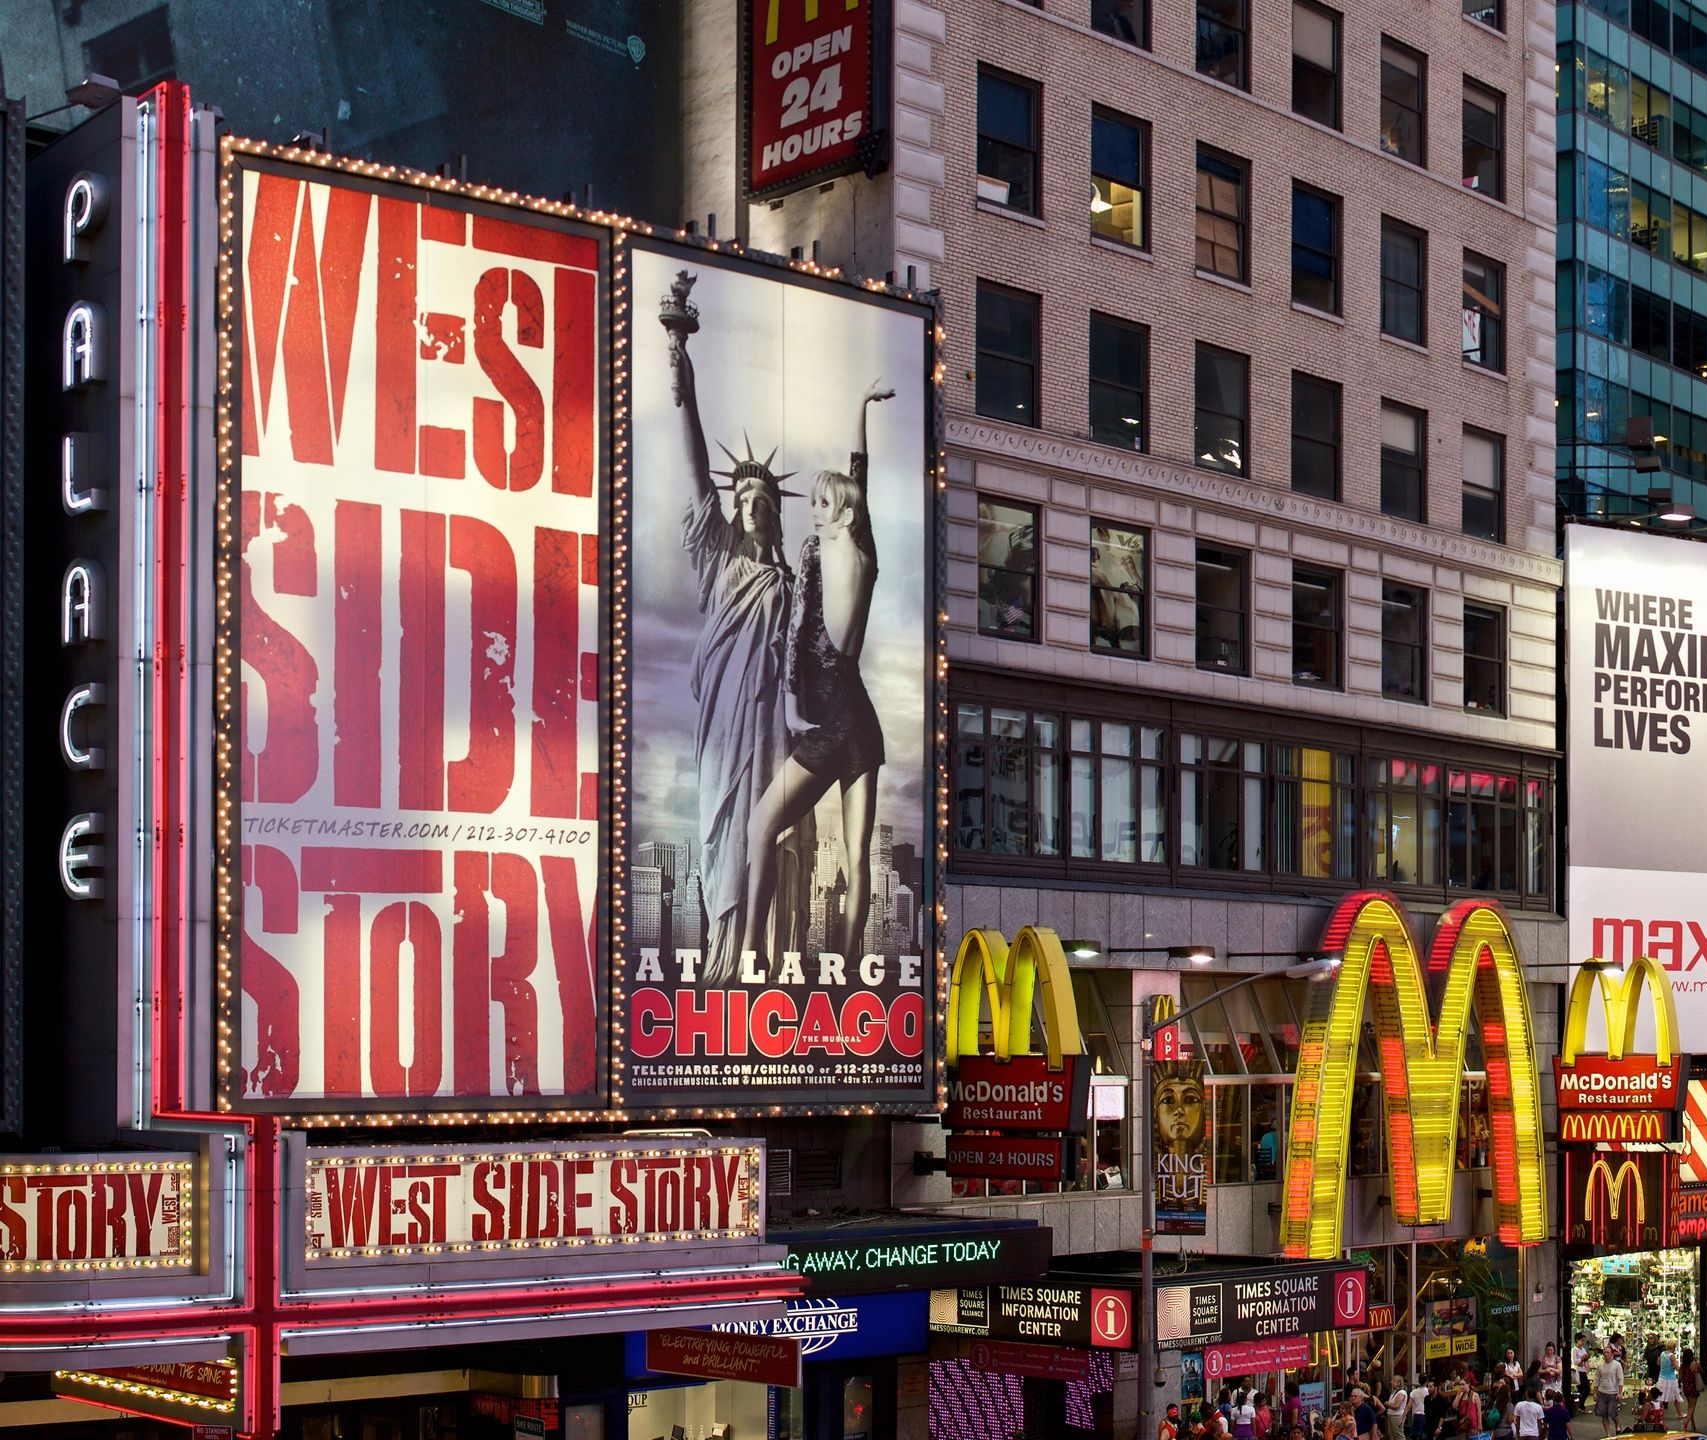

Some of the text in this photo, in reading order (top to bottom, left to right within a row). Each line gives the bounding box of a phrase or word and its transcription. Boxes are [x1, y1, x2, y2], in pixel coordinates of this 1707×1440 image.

[771, 25, 853, 80] OPEN
[780, 63, 843, 129] 24
[761, 110, 863, 172] HOURS
[240, 170, 599, 500] WEST
[58, 174, 107, 903] PALACE
[1594, 587, 1693, 631] WHERE
[240, 489, 599, 822] SIDE
[1593, 706, 1691, 755] LIVES
[466, 823, 592, 846] 212-307-4100
[240, 844, 599, 1101] STORY
[635, 947, 922, 987] AT LARGE
[630, 987, 925, 1058] CHICAGO
[822, 1035, 862, 1043] MUSICAL
[631, 1075, 923, 1087] CHICAGOTHEMUSICAL.COM AMBASSADOR THEATRE BROADWAY
[632, 1063, 923, 1076] TELECHARGE.COM/CHICAGO 212-239-6200
[1559, 1070, 1673, 1090] McDonald's
[949, 1080, 1064, 1103] McDonald's
[1578, 1093, 1653, 1104] Restaurant
[962, 1106, 1043, 1121] Restaurant
[948, 1151, 1055, 1167] OPEN 24 HOURS
[1156, 1153, 1205, 1173] KING
[1157, 1174, 1204, 1199] TUT
[325, 1154, 742, 1249] WEST SIDE STORY
[803, 1239, 1001, 1273] AWAY, CHANGE TODAY
[1000, 1285, 1082, 1306] TIMES SQUARE
[1234, 1276, 1319, 1299] TIMES SQUARE
[1001, 1302, 1080, 1322] INFORMATION
[1236, 1295, 1317, 1319] INFORMATION
[711, 1312, 858, 1336] MONEY EXCHANGE
[1018, 1320, 1062, 1337] CENTER
[1255, 1316, 1299, 1337] CENTER
[732, 1340, 789, 1360] POWERFUL
[1157, 1334, 1223, 1350] TIMESSQUARENYC.ORG
[1454, 1341, 1475, 1352] WIDE
